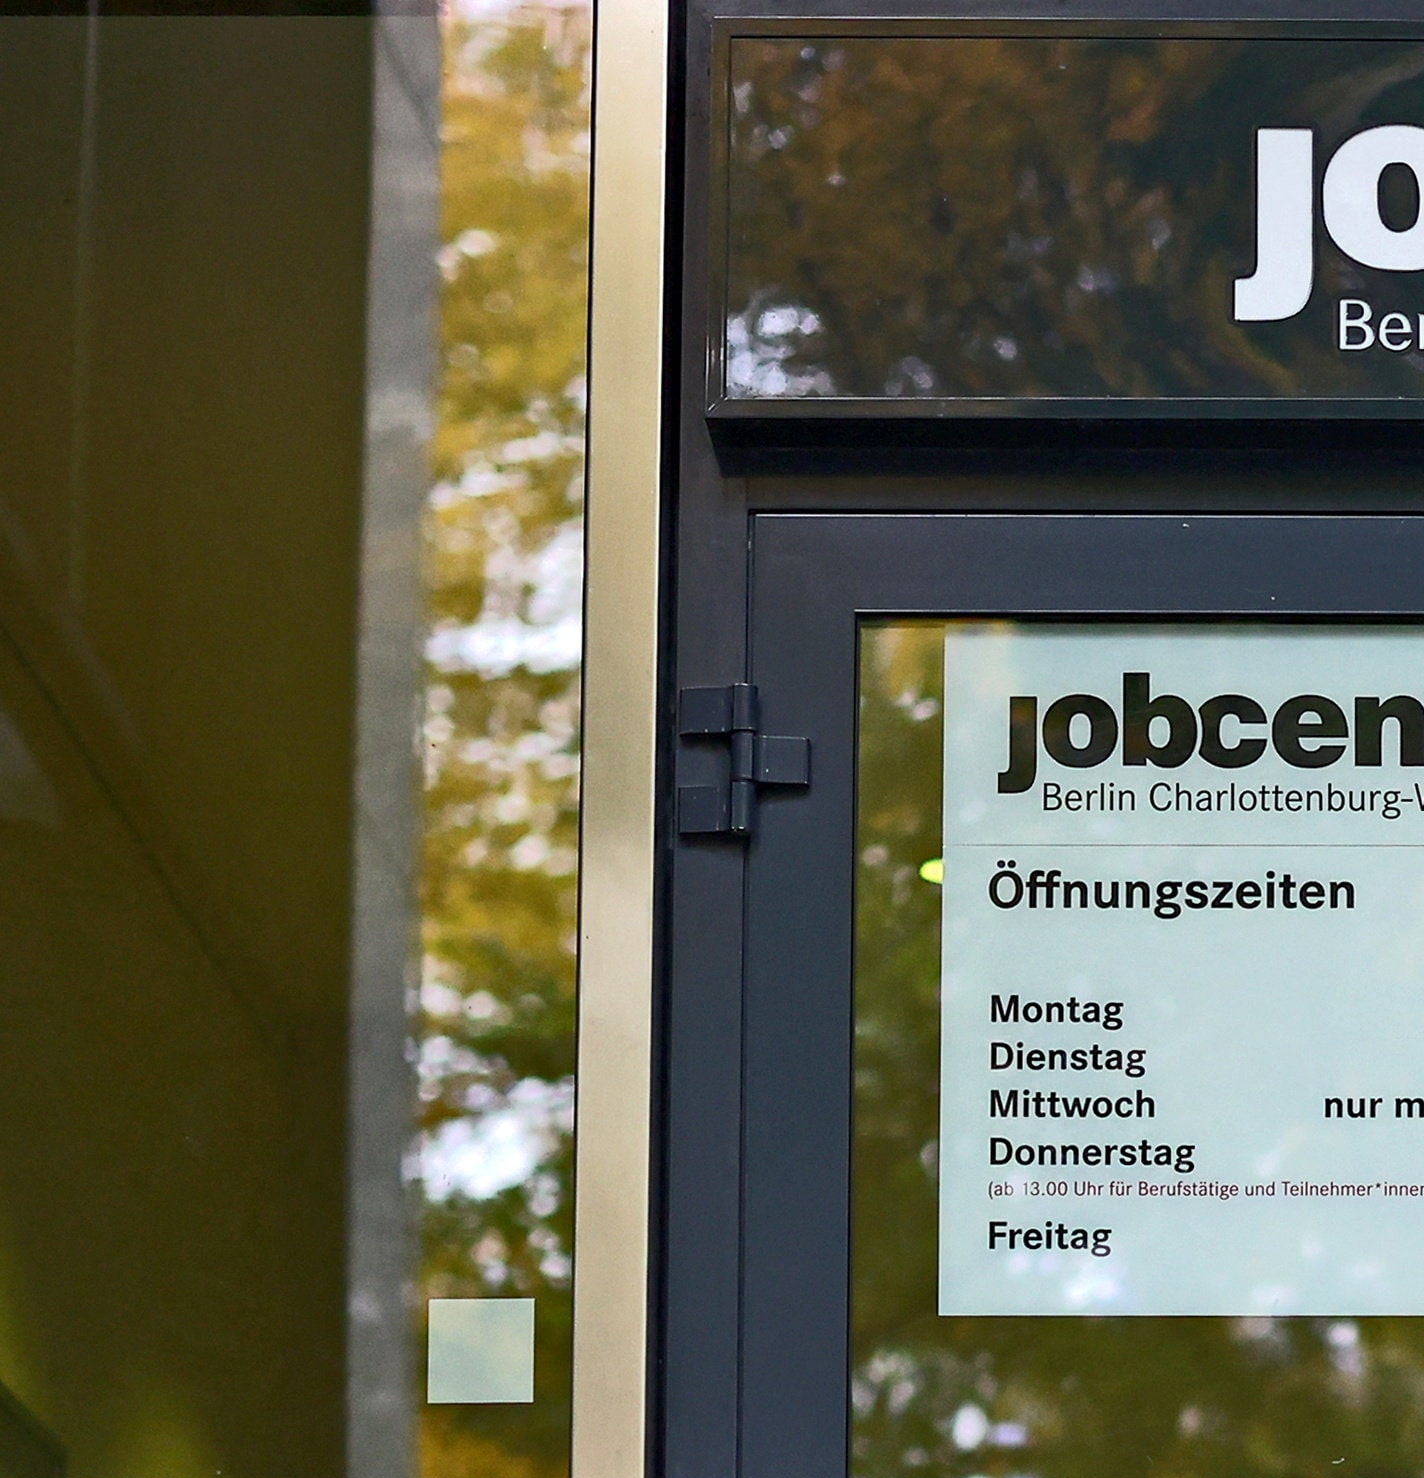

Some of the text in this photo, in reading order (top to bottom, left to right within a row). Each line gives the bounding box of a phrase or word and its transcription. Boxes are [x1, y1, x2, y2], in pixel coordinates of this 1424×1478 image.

[1042, 781, 1136, 812] Berlin
[988, 860, 1356, 919] Öffnungszeiten
[990, 994, 1124, 1031] Montag
[990, 1041, 1147, 1078] Dienstag
[989, 1089, 1155, 1119] Mittwoch
[1324, 1097, 1384, 1119] nur
[989, 1137, 1196, 1174] Donnerstag
[987, 1180, 1014, 1201] (ab
[1023, 1180, 1069, 1198] 13.00
[1073, 1180, 1105, 1198] Uhr
[1109, 1180, 1134, 1198] für
[1138, 1180, 1239, 1201] Berufstätige
[1244, 1180, 1276, 1198] und
[988, 1220, 1113, 1258] Freitag
